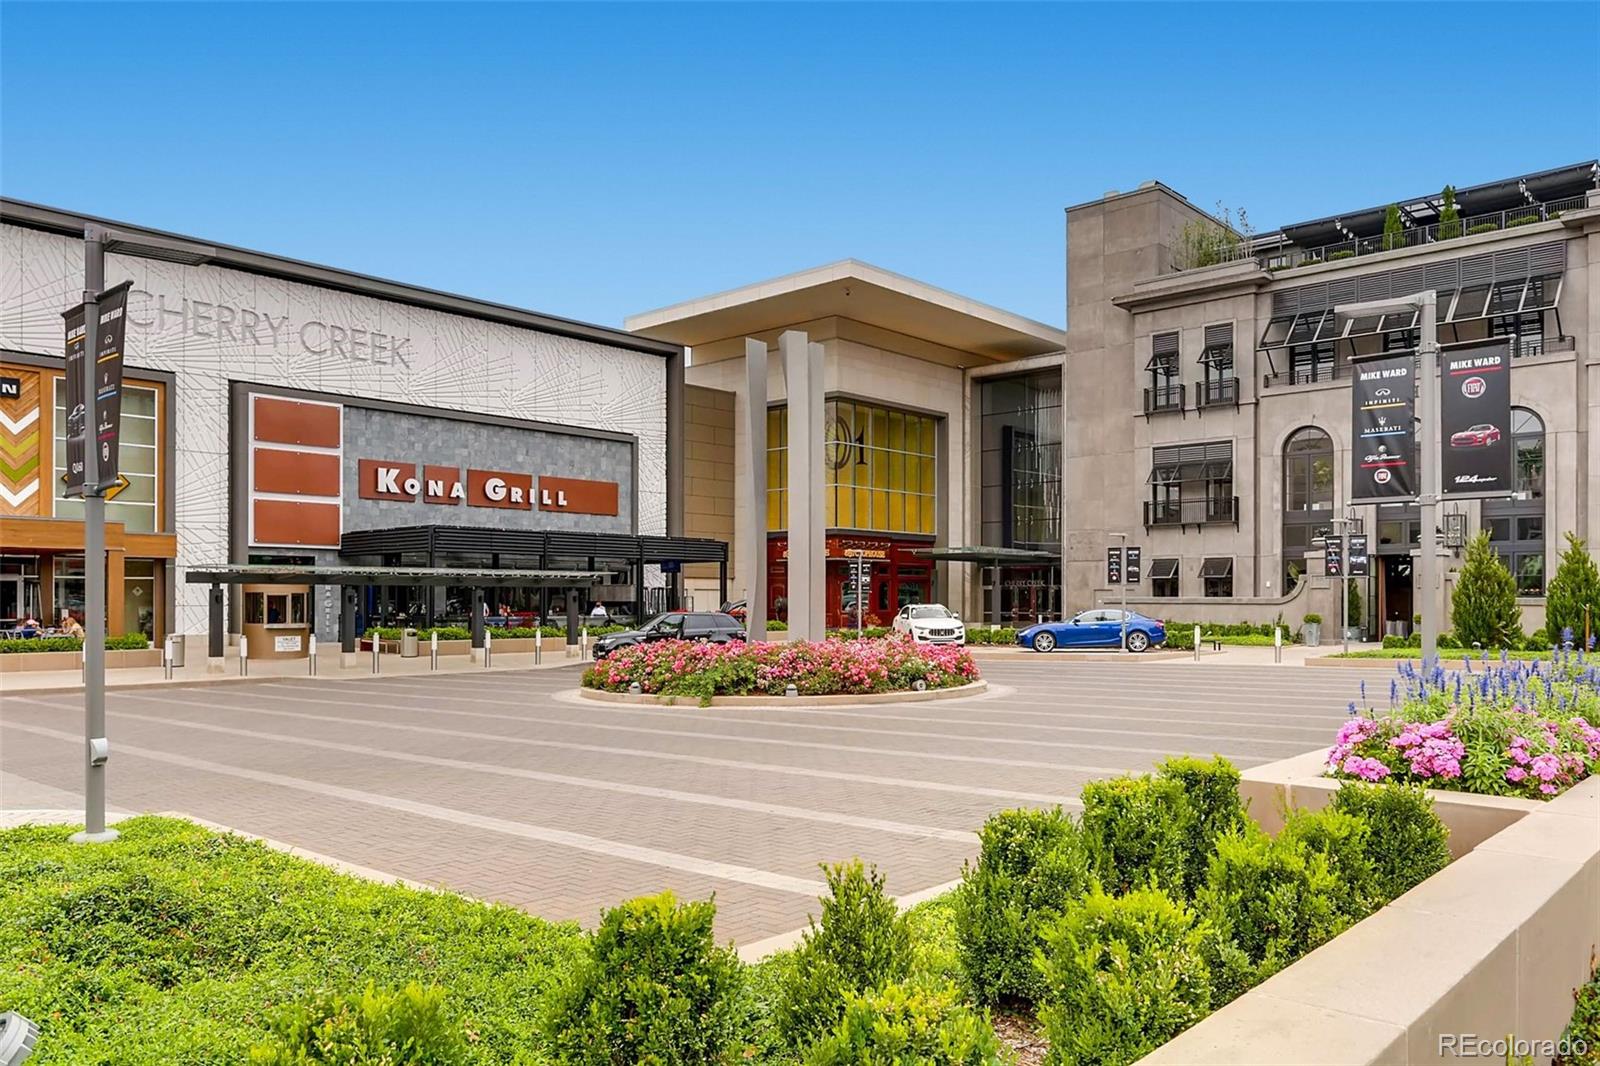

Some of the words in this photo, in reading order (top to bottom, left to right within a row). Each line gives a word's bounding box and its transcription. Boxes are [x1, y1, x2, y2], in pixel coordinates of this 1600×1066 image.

[126, 289, 289, 348] CHERRY
[300, 320, 414, 369] CREEK
[1450, 359, 1473, 370] MIKE
[1473, 356, 1501, 367] WARD
[1360, 371, 1381, 381] MIKE
[1382, 368, 1407, 378] WARD
[1365, 398, 1400, 406] INFINITI
[1364, 425, 1402, 434] MASERATI
[376, 467, 466, 499] KONA
[484, 477, 568, 508] GRILL
